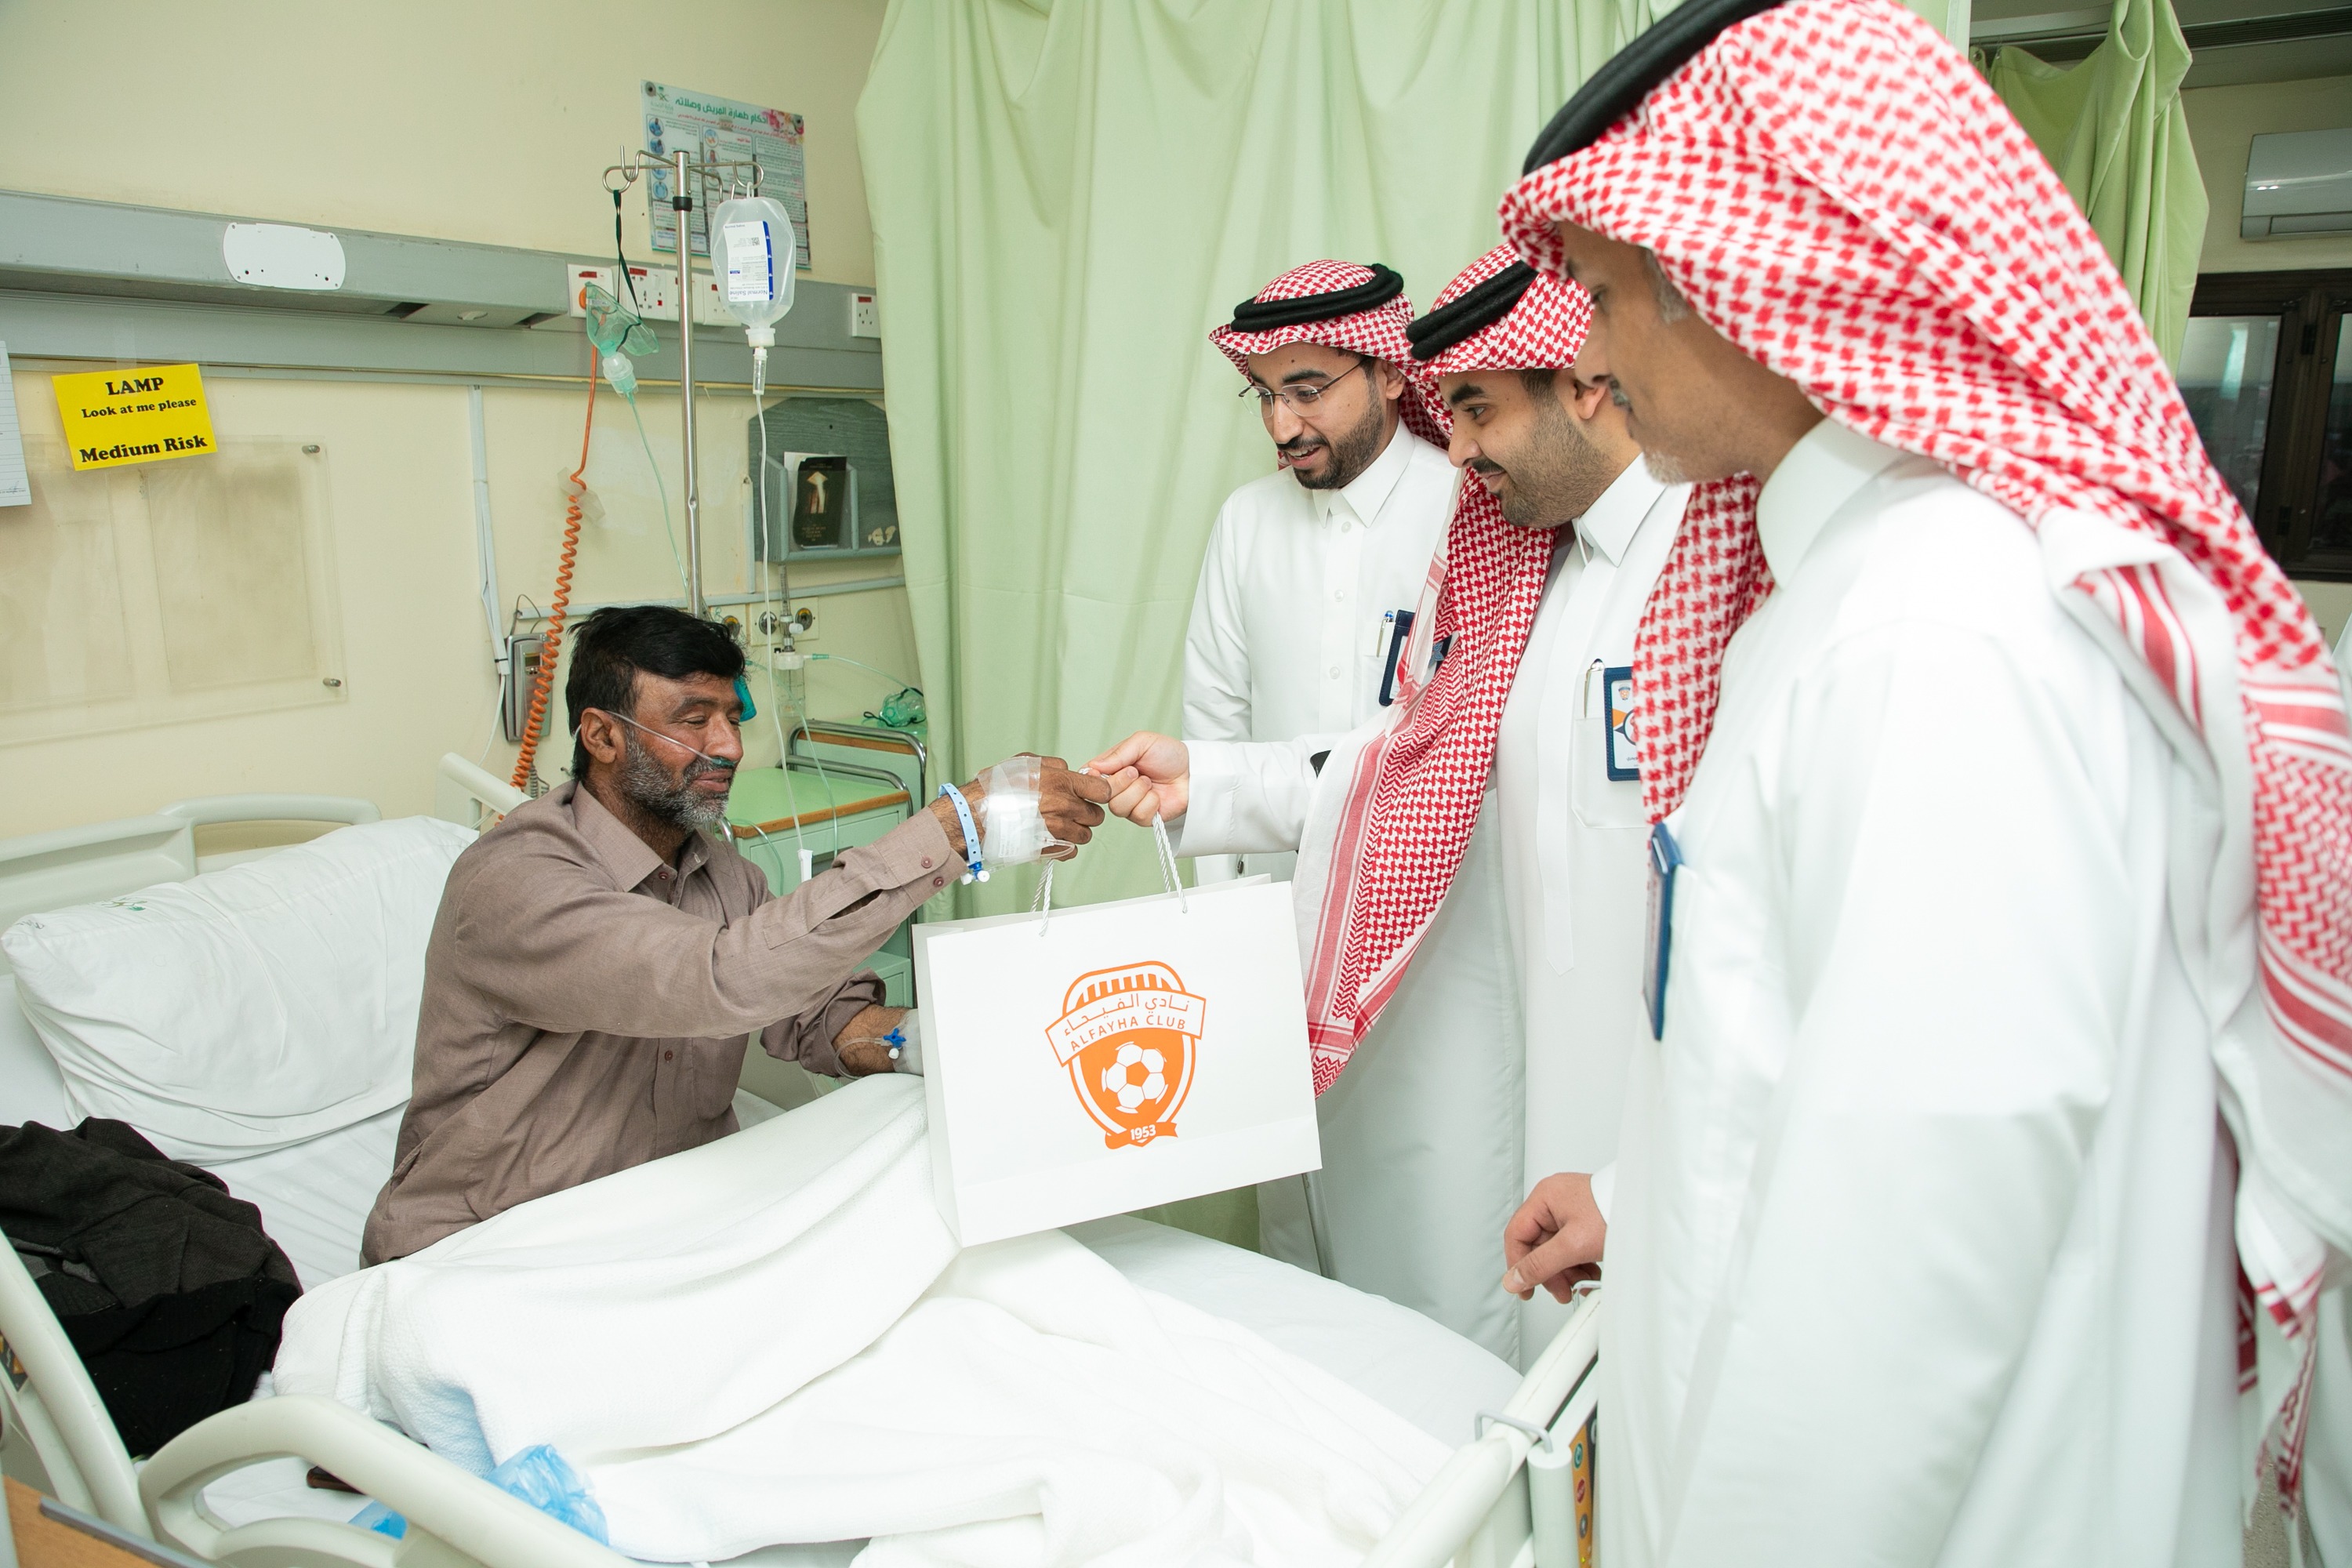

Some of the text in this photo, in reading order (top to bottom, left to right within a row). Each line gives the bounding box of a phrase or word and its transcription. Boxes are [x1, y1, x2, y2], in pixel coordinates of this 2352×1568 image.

[675, 96, 702, 111] وصلاته
[702, 103, 727, 115] المريض
[728, 107, 749, 120] طهارة
[105, 377, 164, 395] LAMP
[82, 398, 197, 418] Look at me please
[79, 435, 208, 463] Medium Risk
[1064, 993, 1190, 1036] نادي الفيحاء
[1070, 1014, 1185, 1051] ALFAYHA CLUB
[1130, 1124, 1156, 1140] 1953
